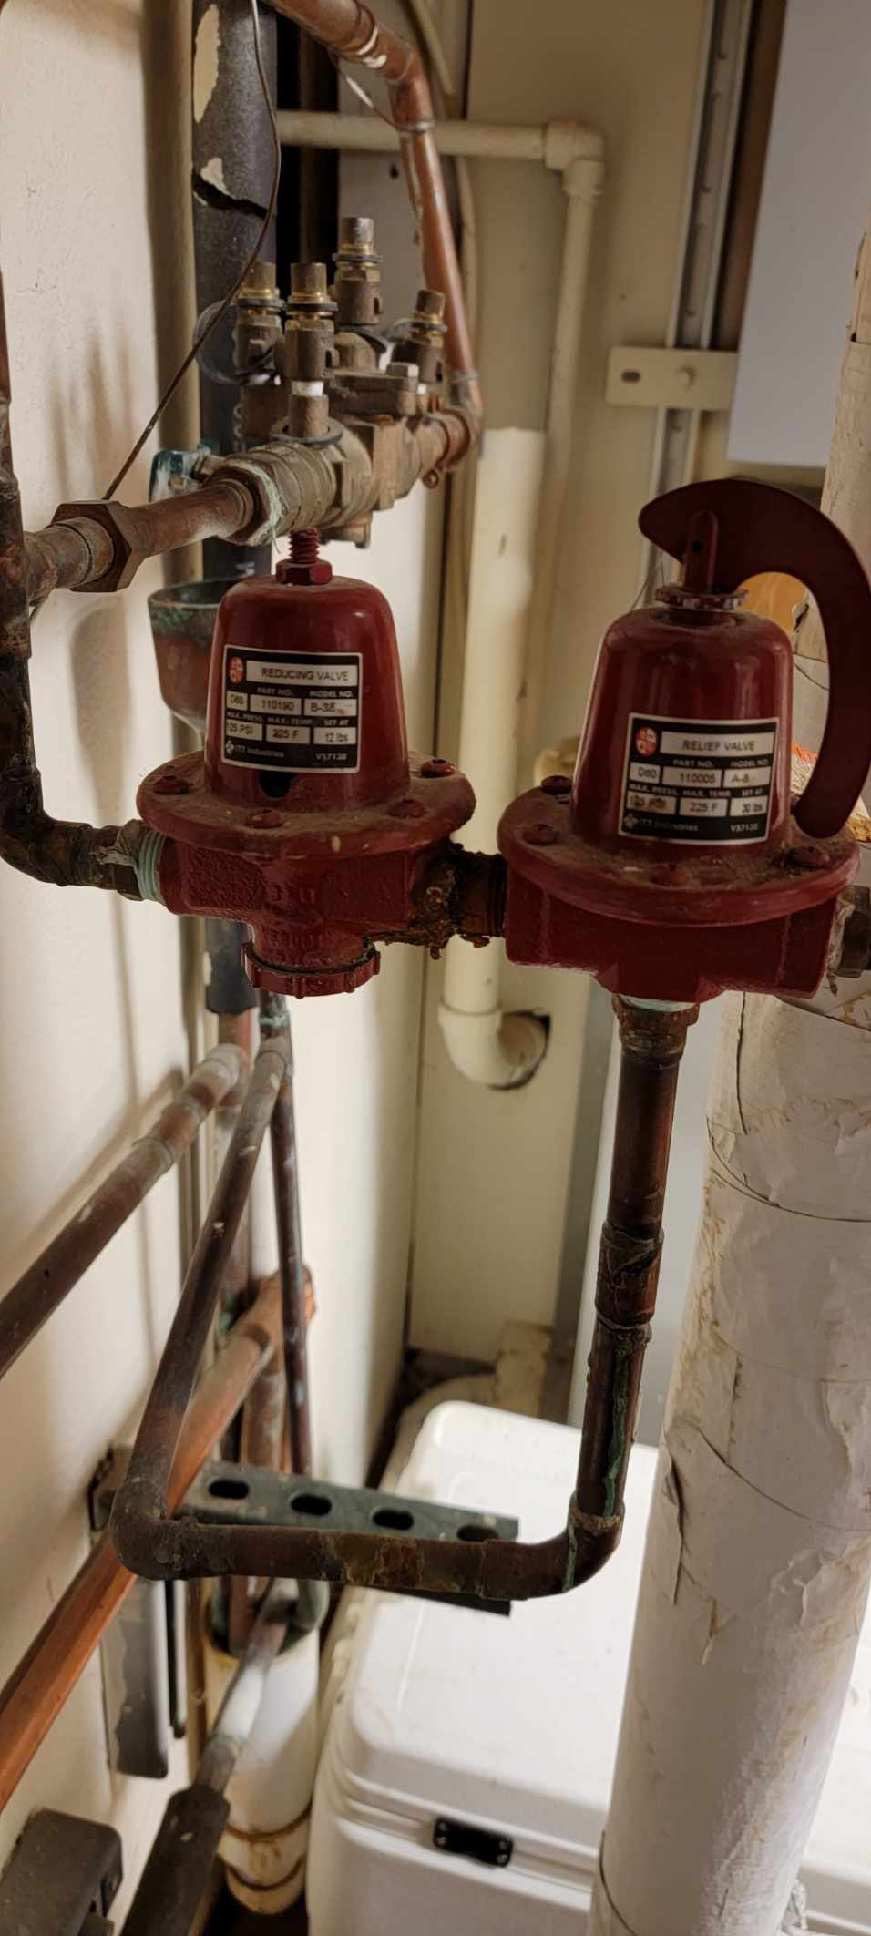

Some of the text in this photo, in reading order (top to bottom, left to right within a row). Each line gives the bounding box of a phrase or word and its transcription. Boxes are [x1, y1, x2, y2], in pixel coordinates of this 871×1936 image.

[261, 667, 348, 681] REDUCING VALVE
[272, 729, 289, 739] 225
[682, 740, 754, 752] RELIEF VALVE
[690, 803, 708, 812] 225
